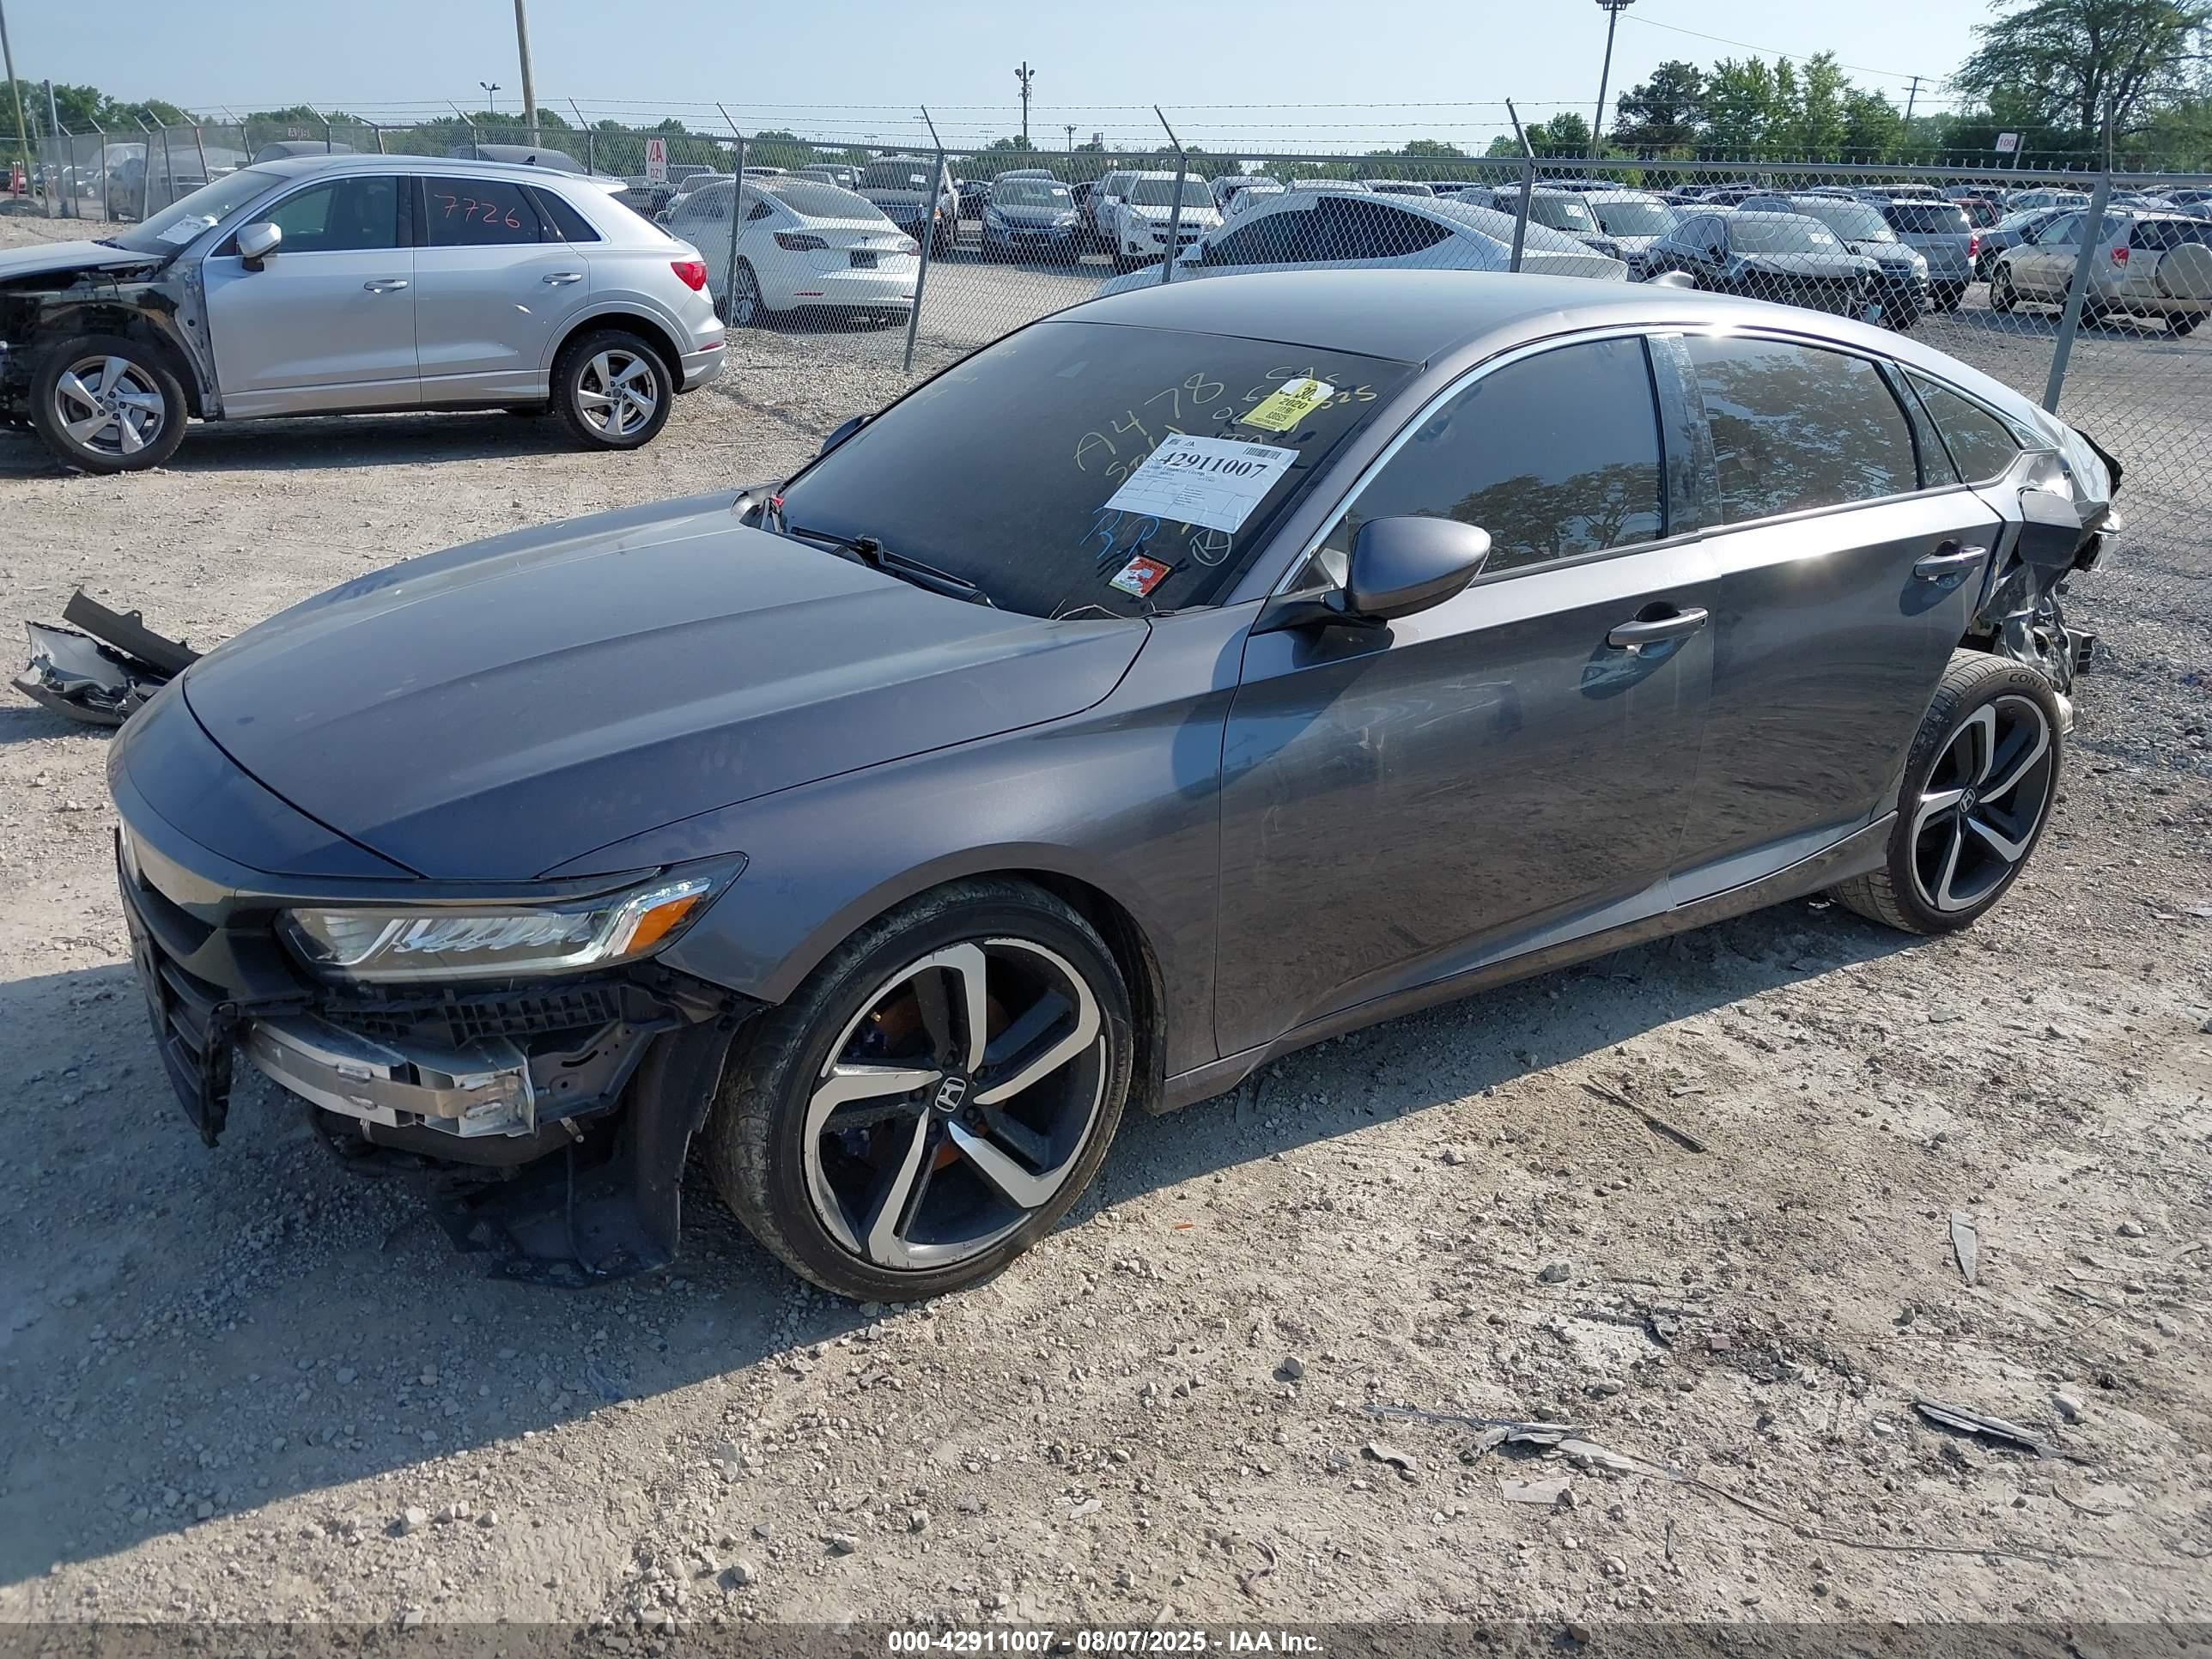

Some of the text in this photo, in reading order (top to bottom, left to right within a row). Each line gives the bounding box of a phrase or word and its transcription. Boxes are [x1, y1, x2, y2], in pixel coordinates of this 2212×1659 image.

[1999, 138, 2014, 147] 100
[434, 194, 520, 228] 7726
[1278, 398, 1309, 410] 2020
[1073, 371, 1224, 472] A478
[1158, 452, 1269, 478] 42911007
